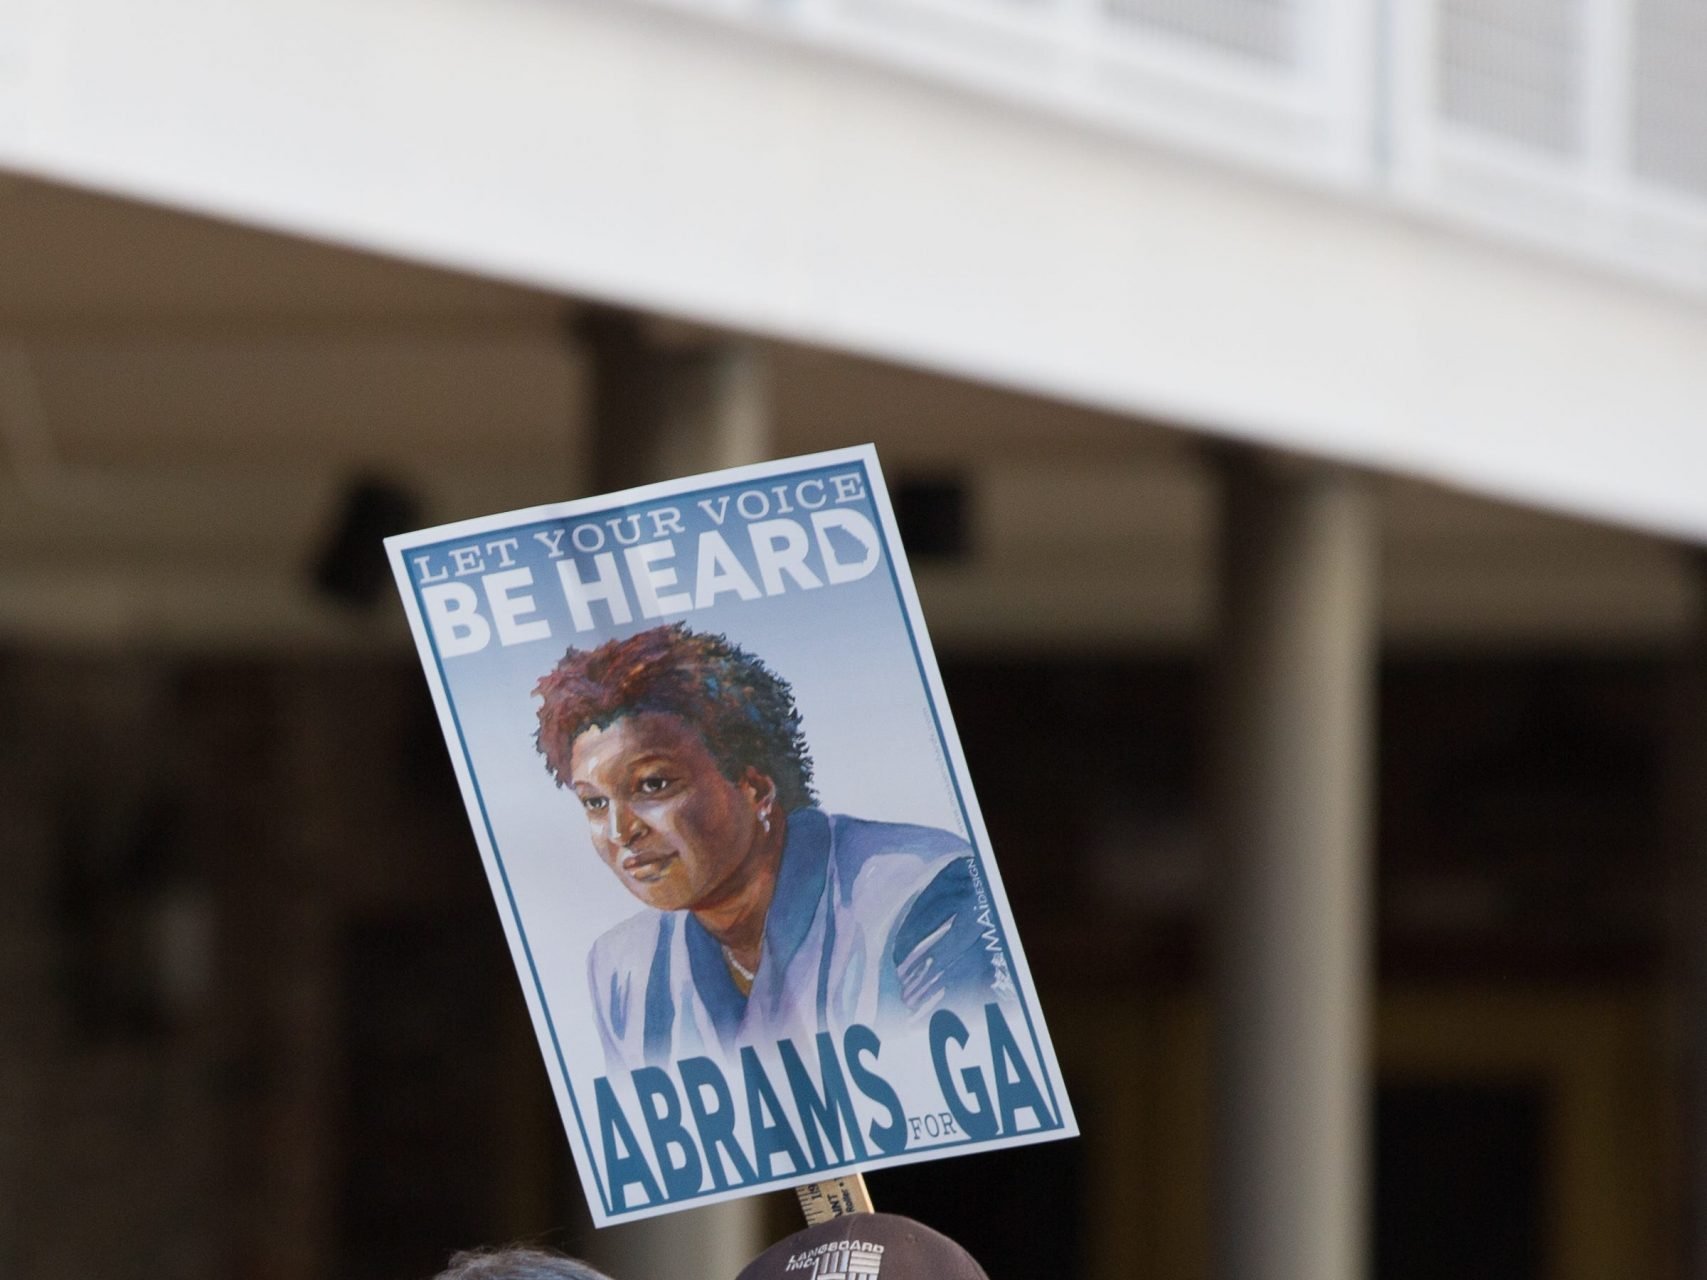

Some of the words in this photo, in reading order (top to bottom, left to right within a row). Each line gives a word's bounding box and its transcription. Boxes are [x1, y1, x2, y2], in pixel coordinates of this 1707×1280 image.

[414, 538, 518, 585] LET
[533, 506, 686, 560] YOUR
[698, 472, 867, 526] VOICE
[421, 566, 552, 659] BE
[556, 507, 881, 633] HEARD
[594, 1023, 908, 1215] ABRAMS
[910, 1112, 957, 1140] FOR
[928, 1002, 1058, 1141] GA
[788, 1240, 885, 1263] LANGBOARD
